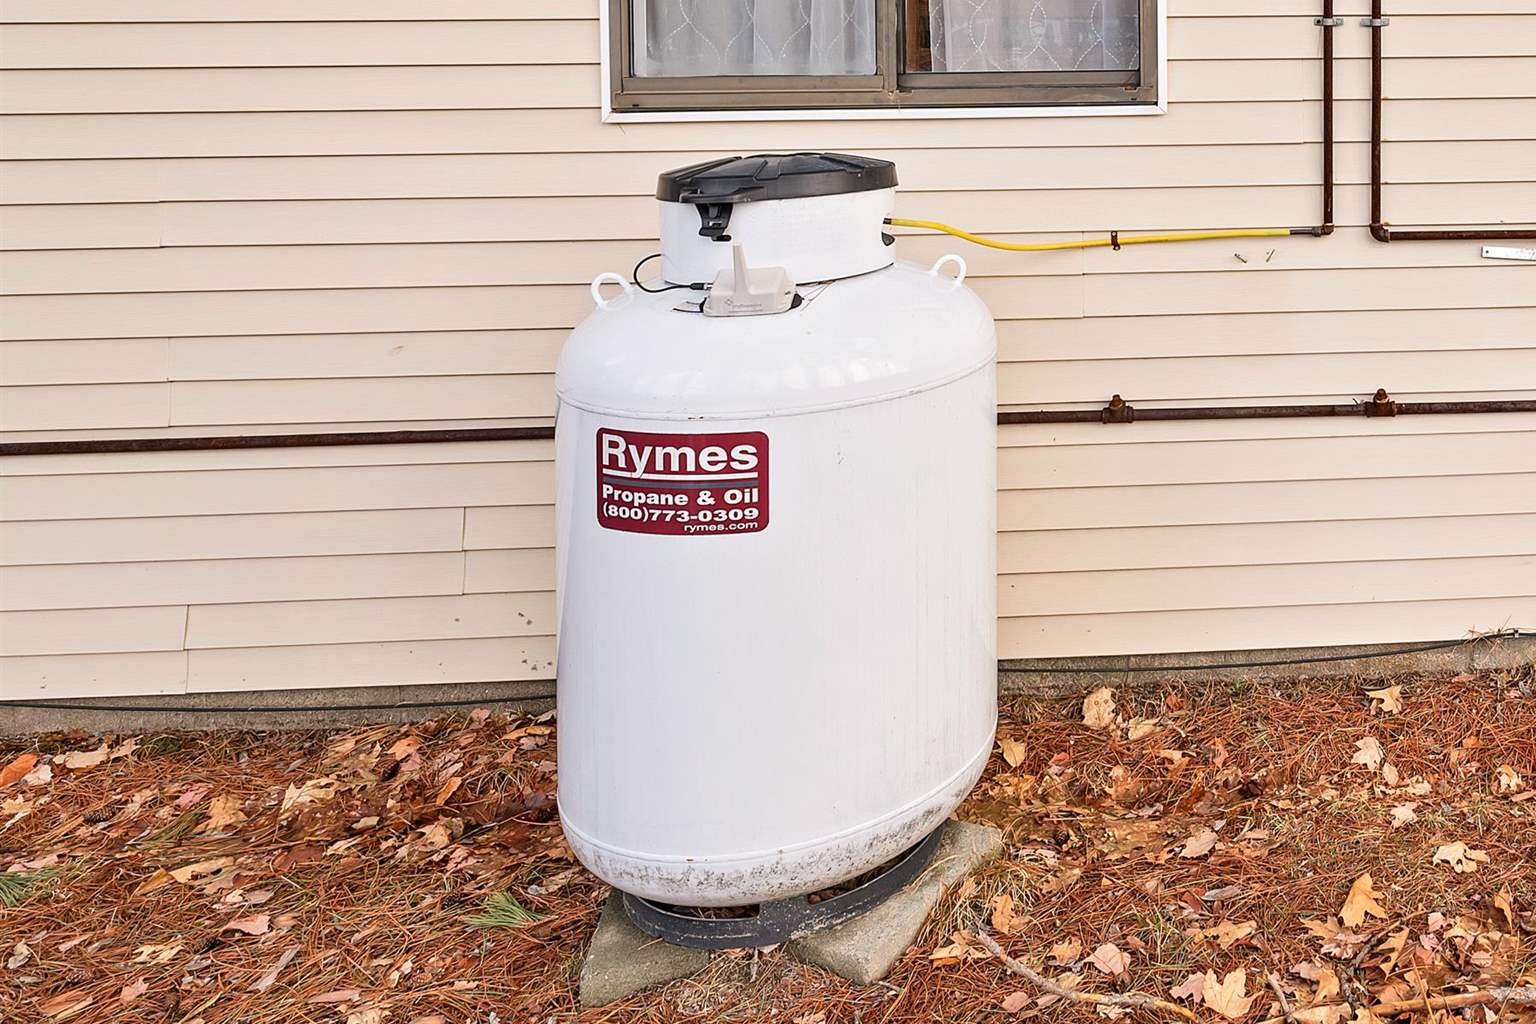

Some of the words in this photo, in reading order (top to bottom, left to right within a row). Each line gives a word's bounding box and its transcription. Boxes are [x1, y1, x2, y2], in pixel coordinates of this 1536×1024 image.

[602, 433, 758, 478] Rymes
[602, 484, 689, 506] Propane
[696, 490, 716, 505] &
[724, 488, 759, 504] Oil
[603, 502, 759, 522] (800)773-0309
[684, 521, 758, 533] rymes.com
